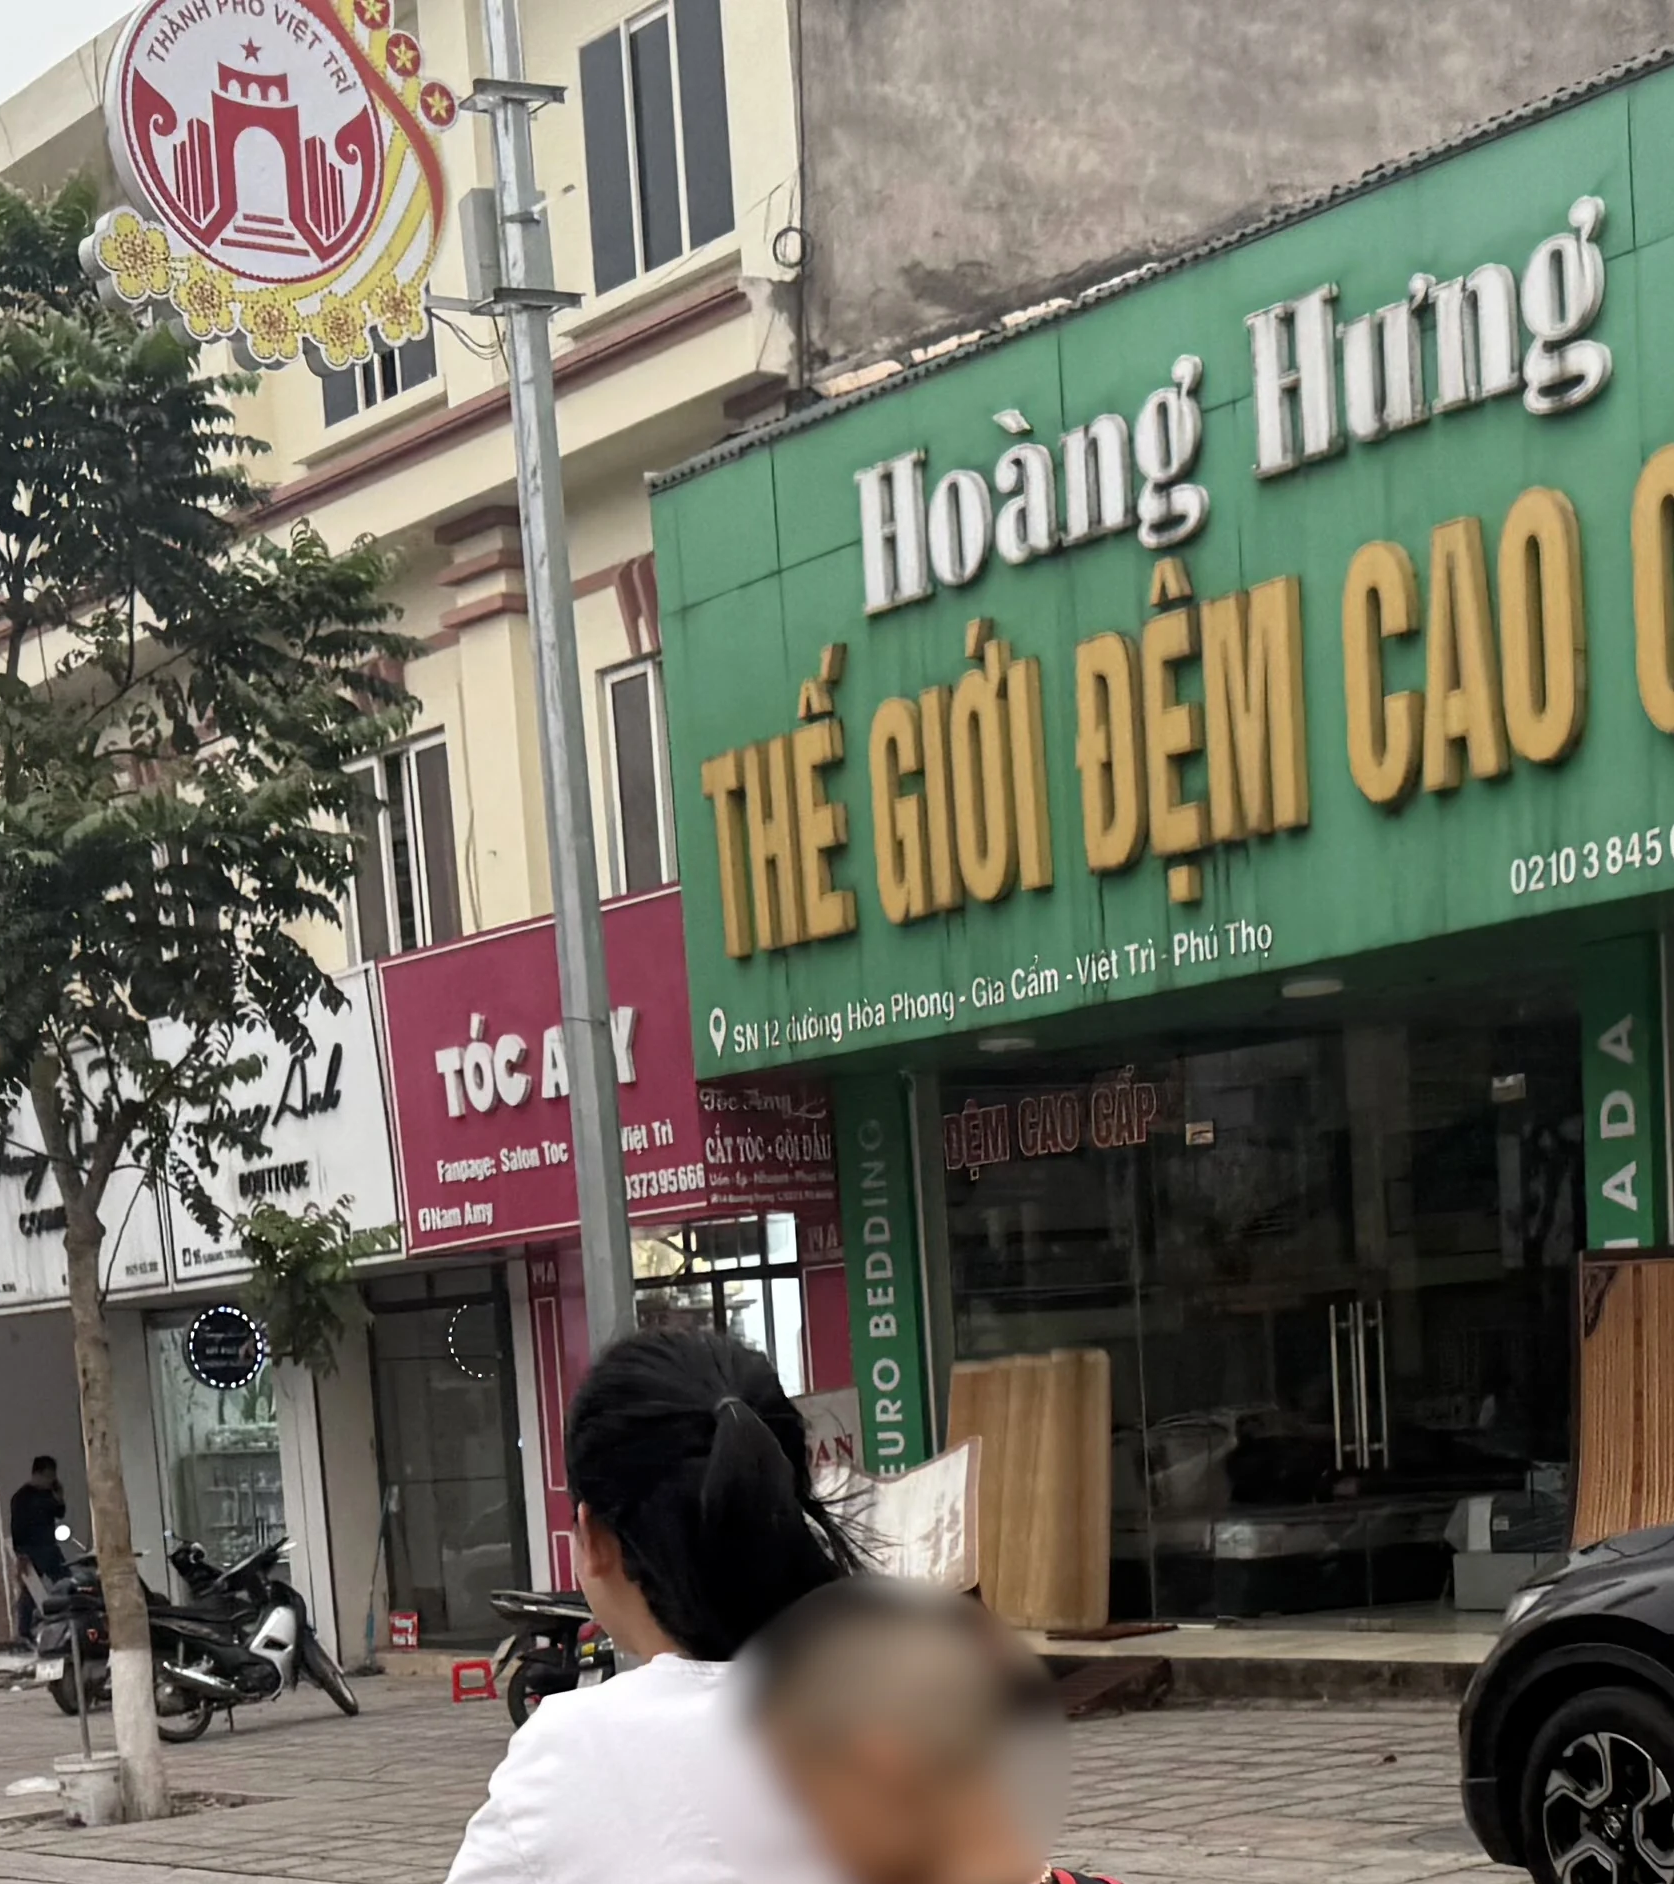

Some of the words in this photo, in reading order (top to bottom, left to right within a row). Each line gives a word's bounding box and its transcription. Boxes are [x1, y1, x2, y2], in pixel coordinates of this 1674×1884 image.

[147, 0, 212, 63] THÀNH
[275, 5, 323, 51] VIỆT
[323, 51, 357, 94] TRÌ
[855, 352, 1211, 617] Hoàng
[1246, 196, 1613, 479] Hưng
[701, 642, 859, 958] THẾ
[868, 617, 1052, 925] GIỚI
[1076, 557, 1310, 904] ĐỆM
[1341, 486, 1587, 806] CAO
[1510, 846, 1576, 895] 0210
[1582, 840, 1600, 880] 3
[1606, 826, 1663, 875] 845
[733, 1021, 759, 1053] SN
[764, 1018, 780, 1048] 12
[847, 998, 885, 1033] Hòa
[892, 990, 955, 1023] Phong
[972, 976, 1005, 1008] Gia
[1010, 955, 1059, 999] Cẩm
[1075, 950, 1118, 987] Việt
[1124, 938, 1156, 976] Trì
[1173, 924, 1219, 967] Phú
[1224, 918, 1273, 958] Thọ
[435, 1012, 533, 1117] TÓC
[542, 1005, 637, 1098] AY
[437, 1156, 497, 1183] Fanpage:
[500, 1145, 540, 1173] Salon
[943, 1098, 1011, 1181] ĐỆM
[1018, 1093, 1080, 1157] CAO
[1091, 1064, 1157, 1148] CẤP
[1597, 1013, 1639, 1249] ADA
[431, 1206, 462, 1231] Nam
[873, 1357, 906, 1478] EURO
